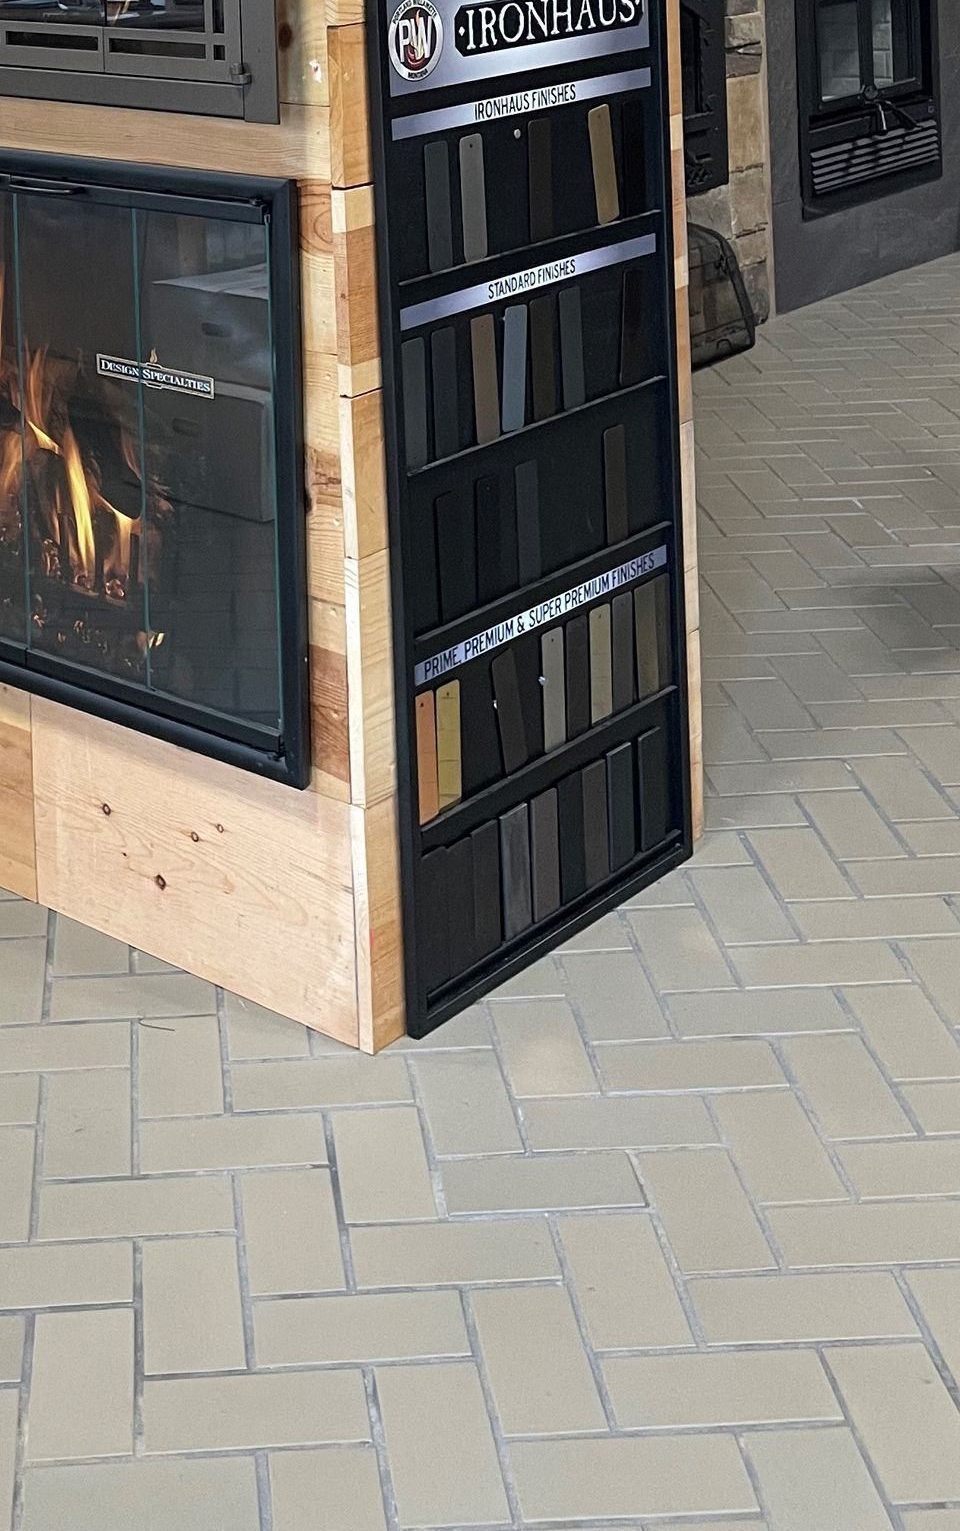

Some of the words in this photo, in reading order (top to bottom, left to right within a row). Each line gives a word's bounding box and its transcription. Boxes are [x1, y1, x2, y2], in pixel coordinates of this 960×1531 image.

[398, 15, 432, 63] PW
[474, 93, 530, 121] IRONHAUS
[531, 84, 576, 109] FINISHES
[488, 271, 536, 299] STANDARD
[537, 259, 576, 285] FINISHES
[101, 359, 140, 377] DESIGN
[142, 369, 211, 392] SPECIALTIES
[464, 619, 515, 665] PREMIUM
[516, 616, 526, 633] &
[528, 601, 562, 627] SUPER
[564, 576, 610, 610] PREMIUM
[611, 552, 655, 588] FINISHES
